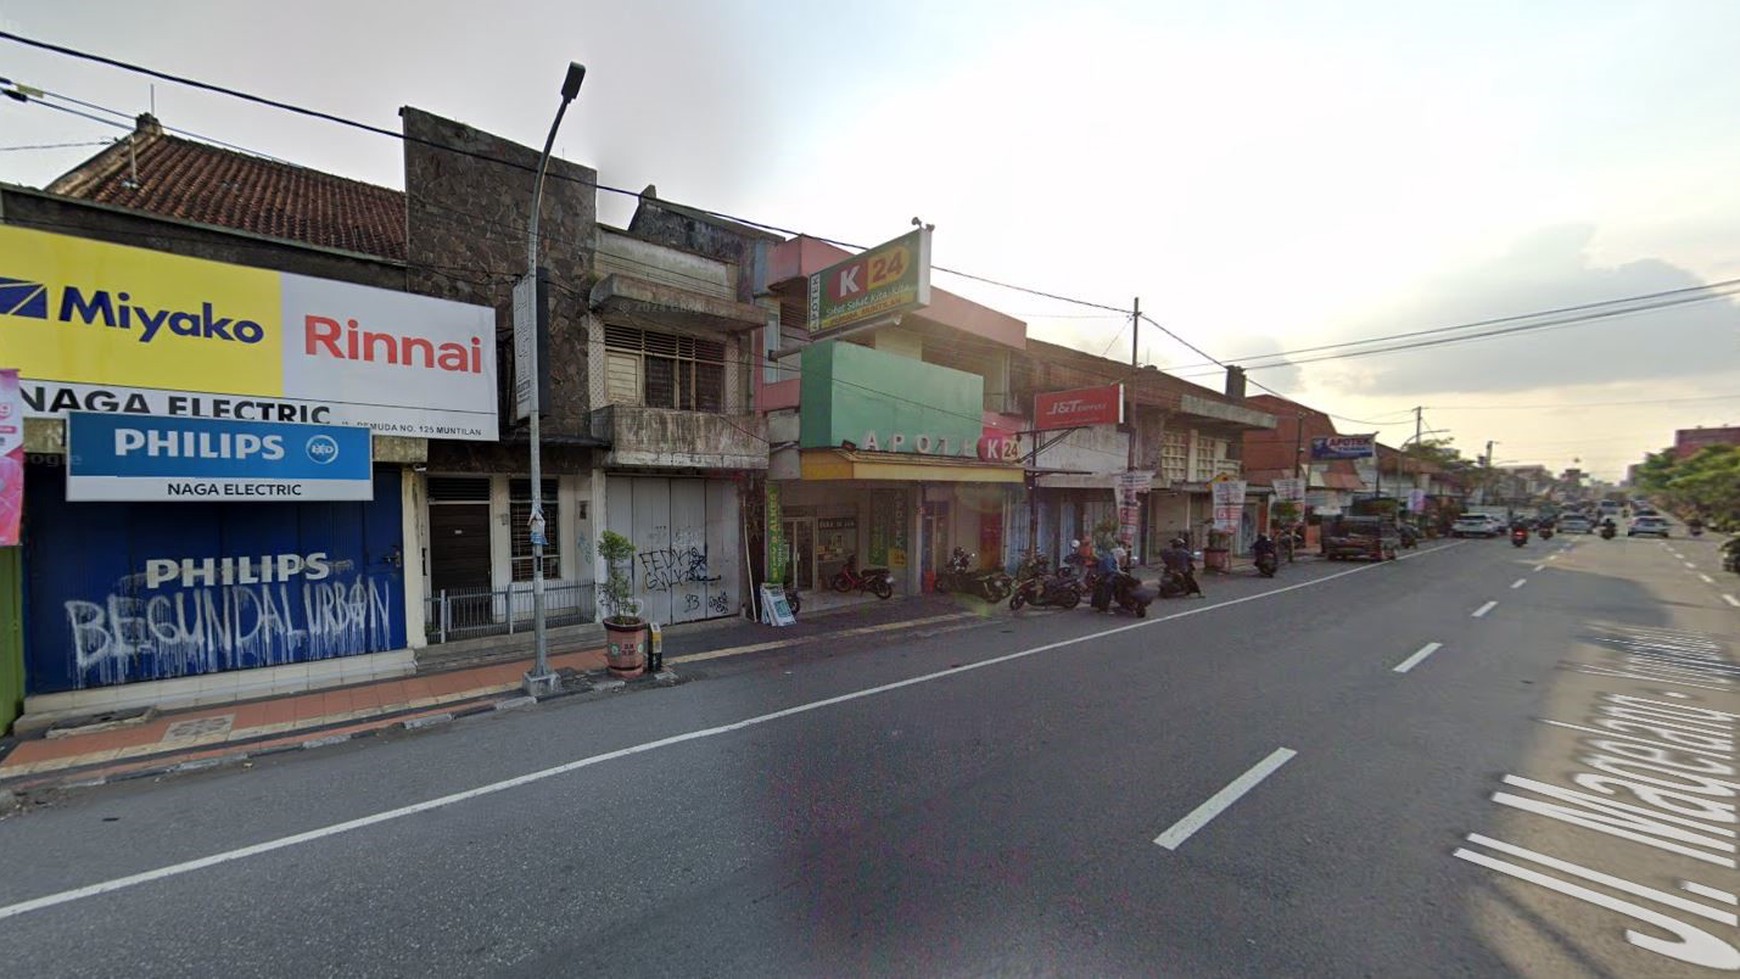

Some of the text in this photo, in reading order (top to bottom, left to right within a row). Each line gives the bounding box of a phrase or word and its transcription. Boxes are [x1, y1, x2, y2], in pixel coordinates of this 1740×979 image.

[840, 250, 904, 297] K 24
[59, 286, 264, 343] Miyako
[304, 314, 482, 374] Rinnai
[19, 386, 331, 425] NAGA ELECTRIC
[114, 428, 285, 461] PHILIPS
[436, 427, 482, 436] MUNTILAN
[1005, 442, 1018, 458] 24
[167, 483, 302, 497] NAGA ELECTRIC
[146, 552, 330, 589] PHILIPS
[304, 574, 390, 642] URBAN
